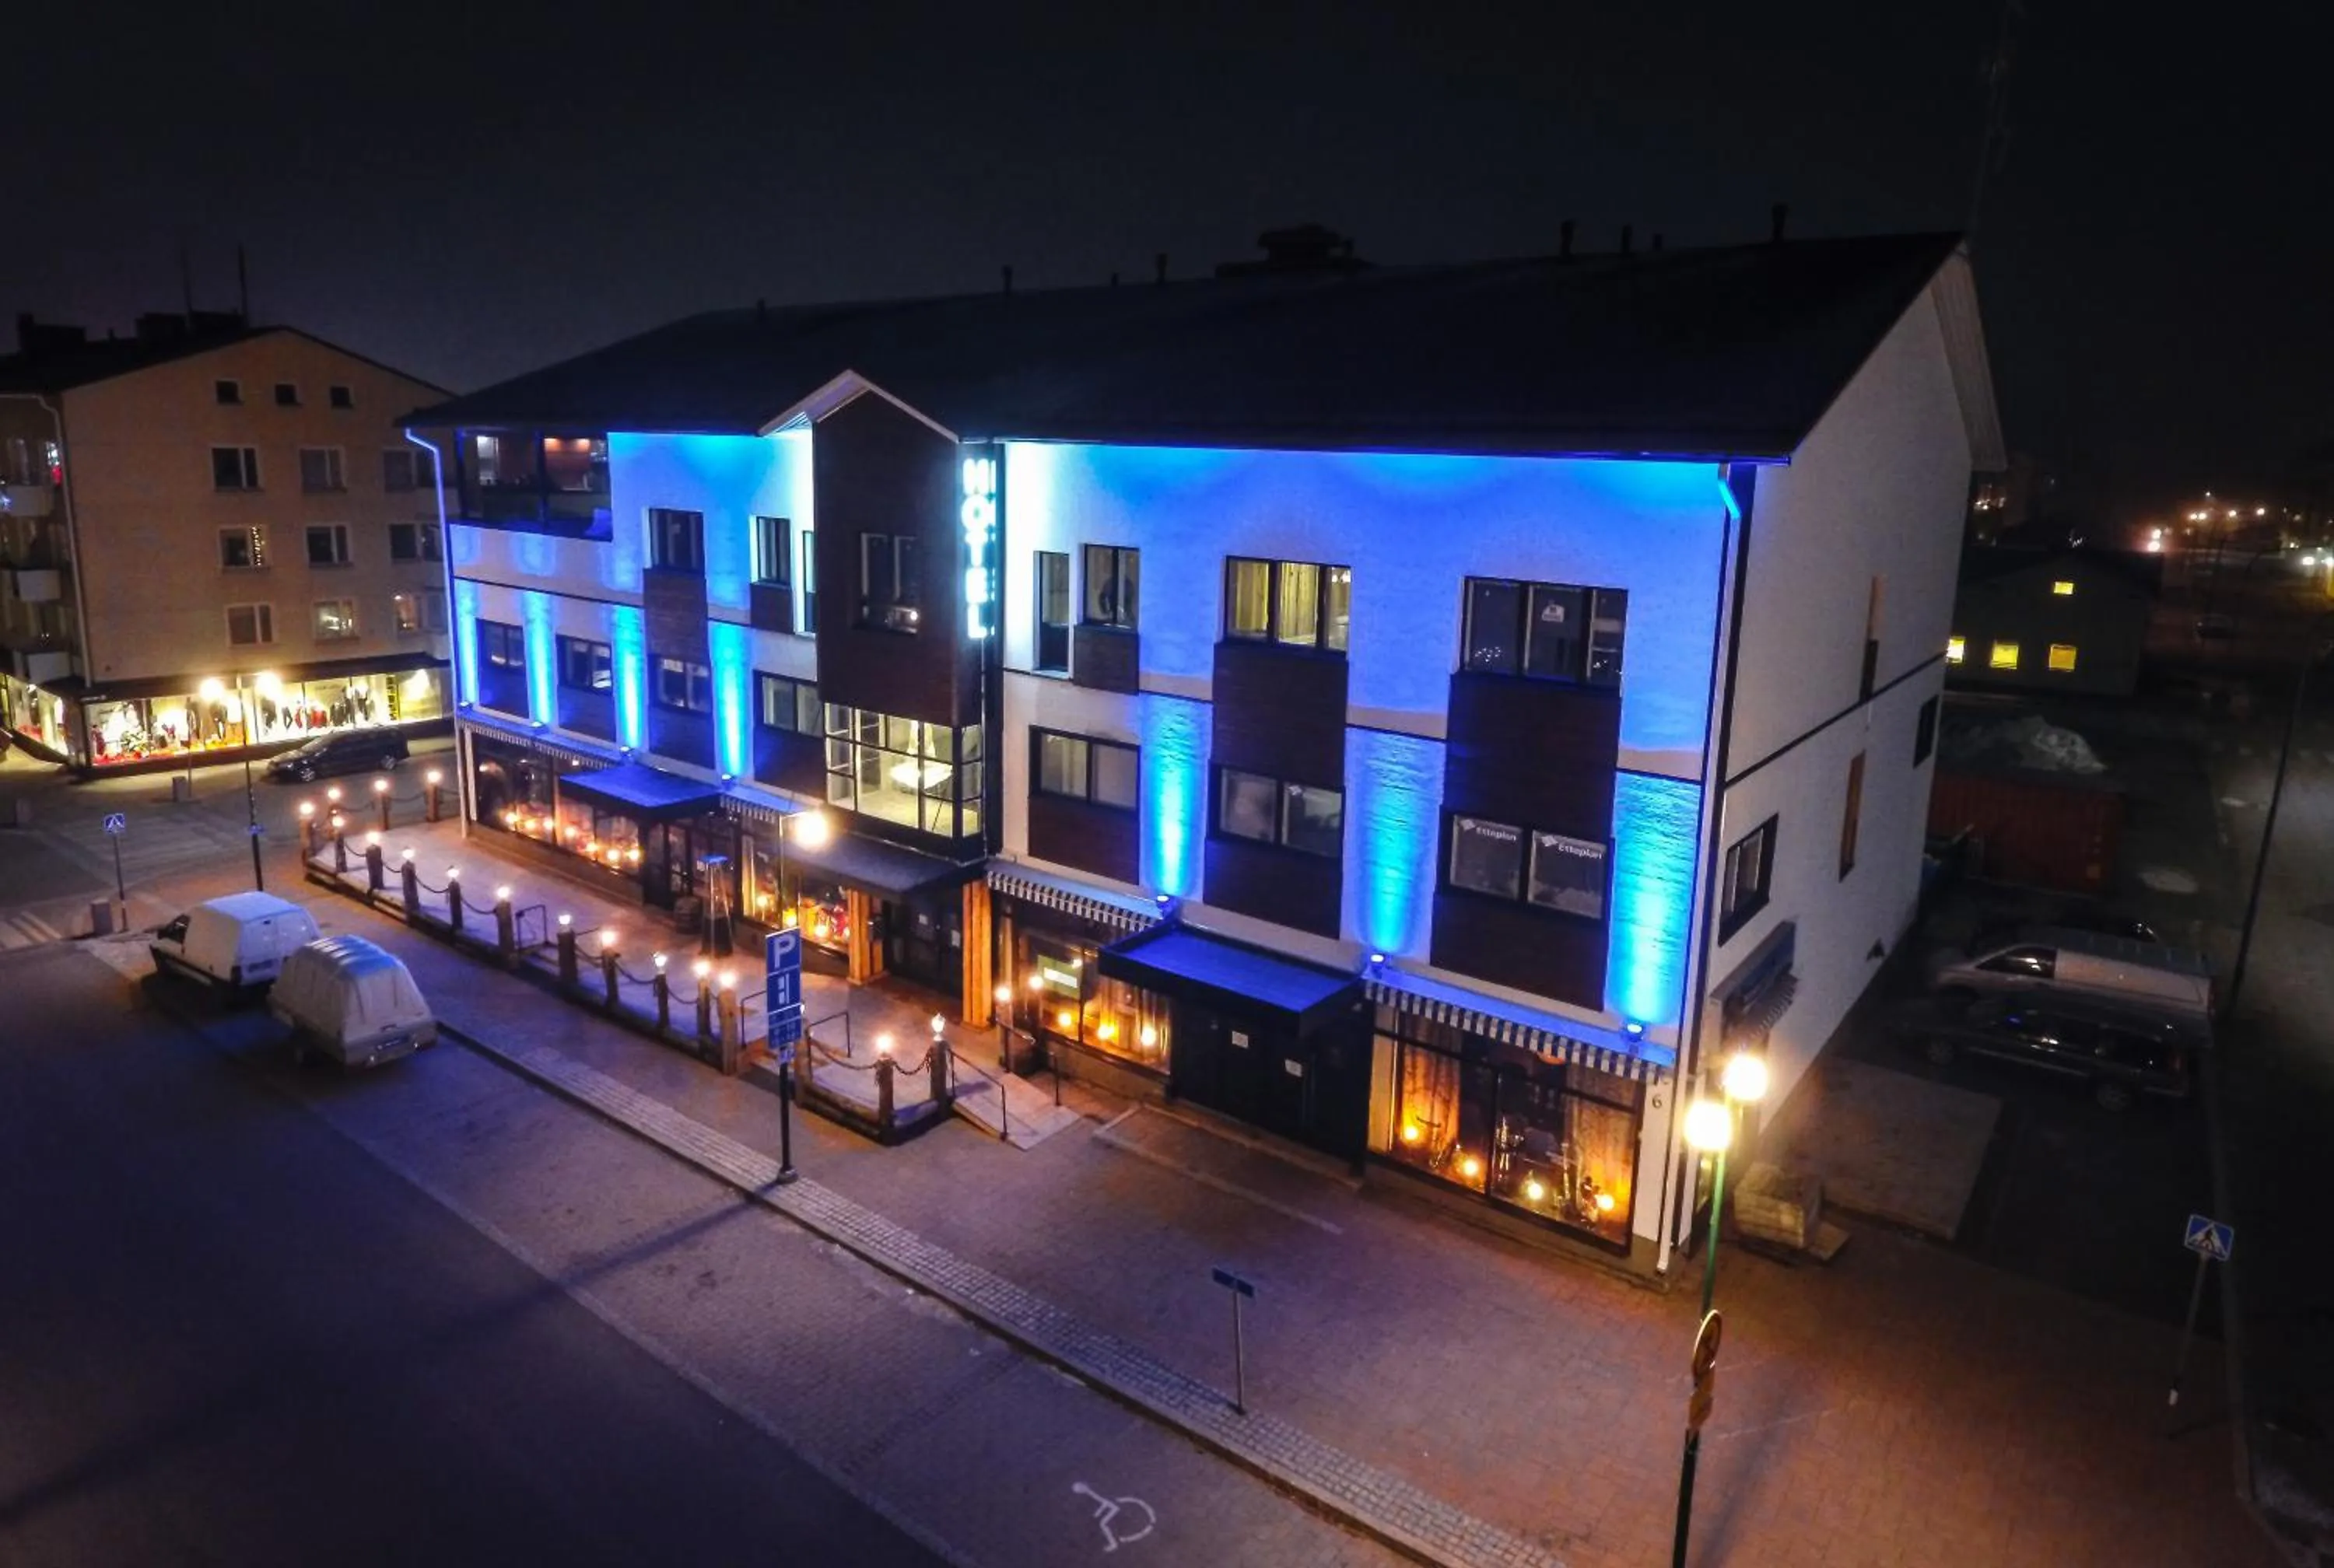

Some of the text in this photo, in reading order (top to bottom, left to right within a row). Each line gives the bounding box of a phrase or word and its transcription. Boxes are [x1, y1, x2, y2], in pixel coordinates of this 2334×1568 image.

[962, 458, 990, 639] HOTEL
[773, 934, 797, 968] P
[1652, 1093, 1663, 1109] 6
